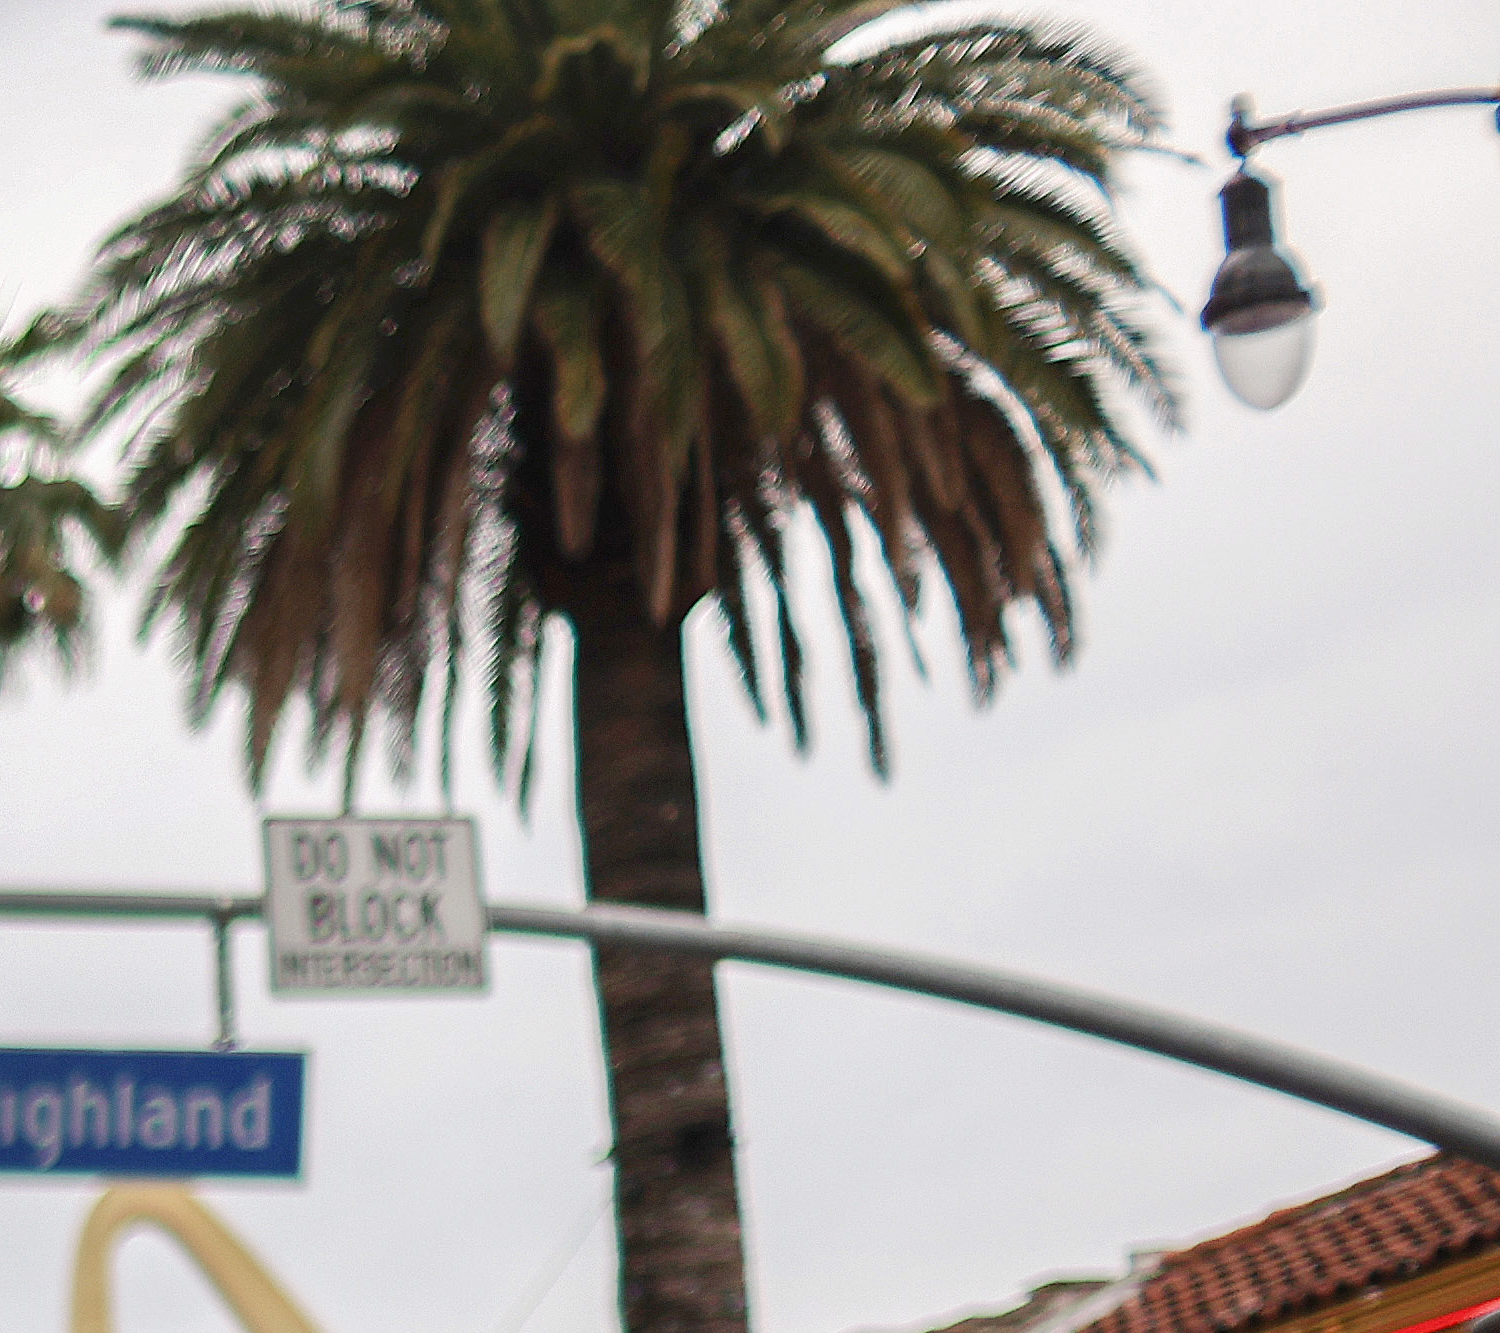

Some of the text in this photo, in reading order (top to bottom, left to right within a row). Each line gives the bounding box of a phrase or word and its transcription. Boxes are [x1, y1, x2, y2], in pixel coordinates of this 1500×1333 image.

[291, 831, 451, 882] DO NOT
[306, 893, 444, 944] BLOCK
[278, 949, 482, 990] INTERSECTION
